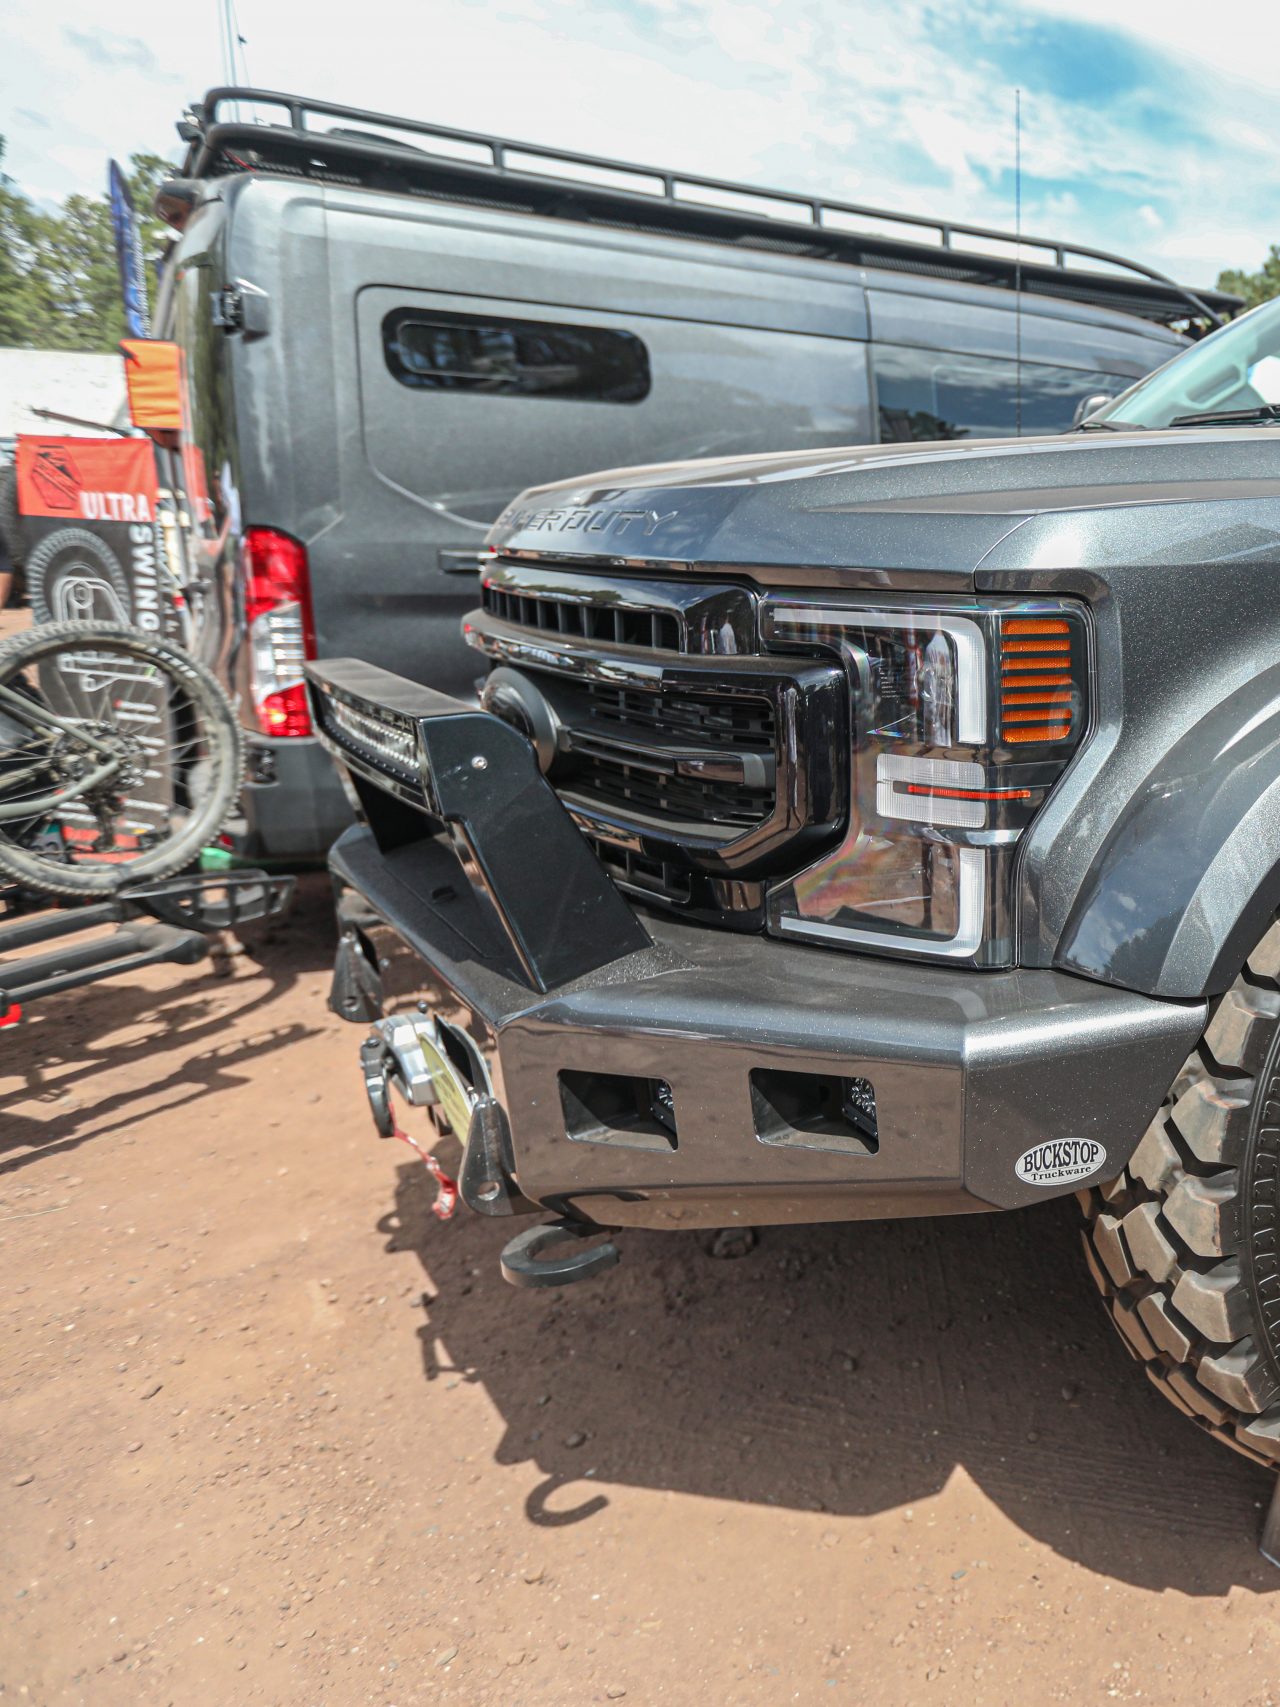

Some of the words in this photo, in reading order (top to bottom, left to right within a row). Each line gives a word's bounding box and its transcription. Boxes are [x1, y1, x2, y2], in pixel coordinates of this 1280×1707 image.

[79, 491, 152, 521] ULTRA
[559, 509, 679, 536] DUTY
[129, 523, 160, 631] SWING
[1023, 1141, 1099, 1173] BUCKSTOP
[1031, 1166, 1092, 1181] Truckware
